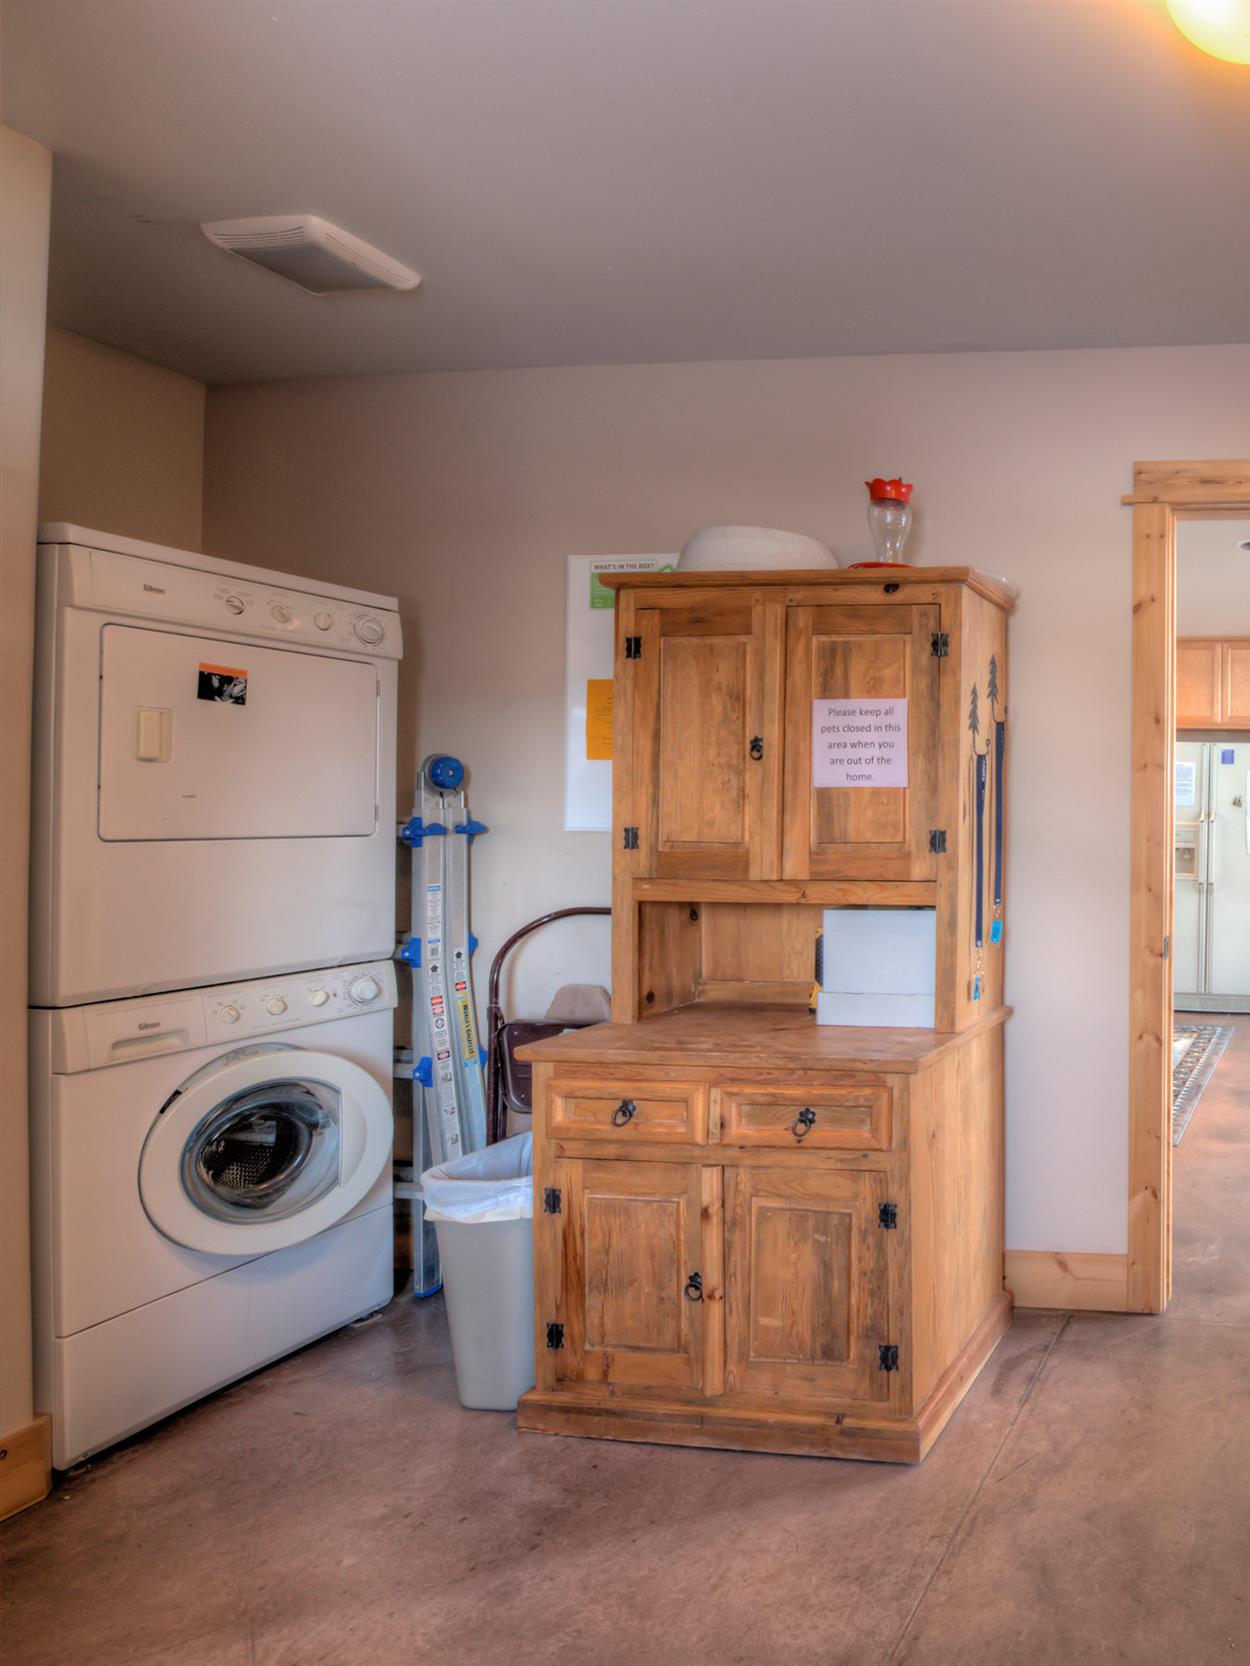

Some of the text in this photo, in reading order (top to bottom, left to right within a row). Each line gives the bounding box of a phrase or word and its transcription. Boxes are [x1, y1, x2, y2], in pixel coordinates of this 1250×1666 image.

[828, 706, 895, 718] Please keep all
[820, 723, 902, 734] pets closed in this
[827, 740, 895, 750] area when you
[829, 756, 892, 766] are out of the
[846, 772, 876, 782] home.
